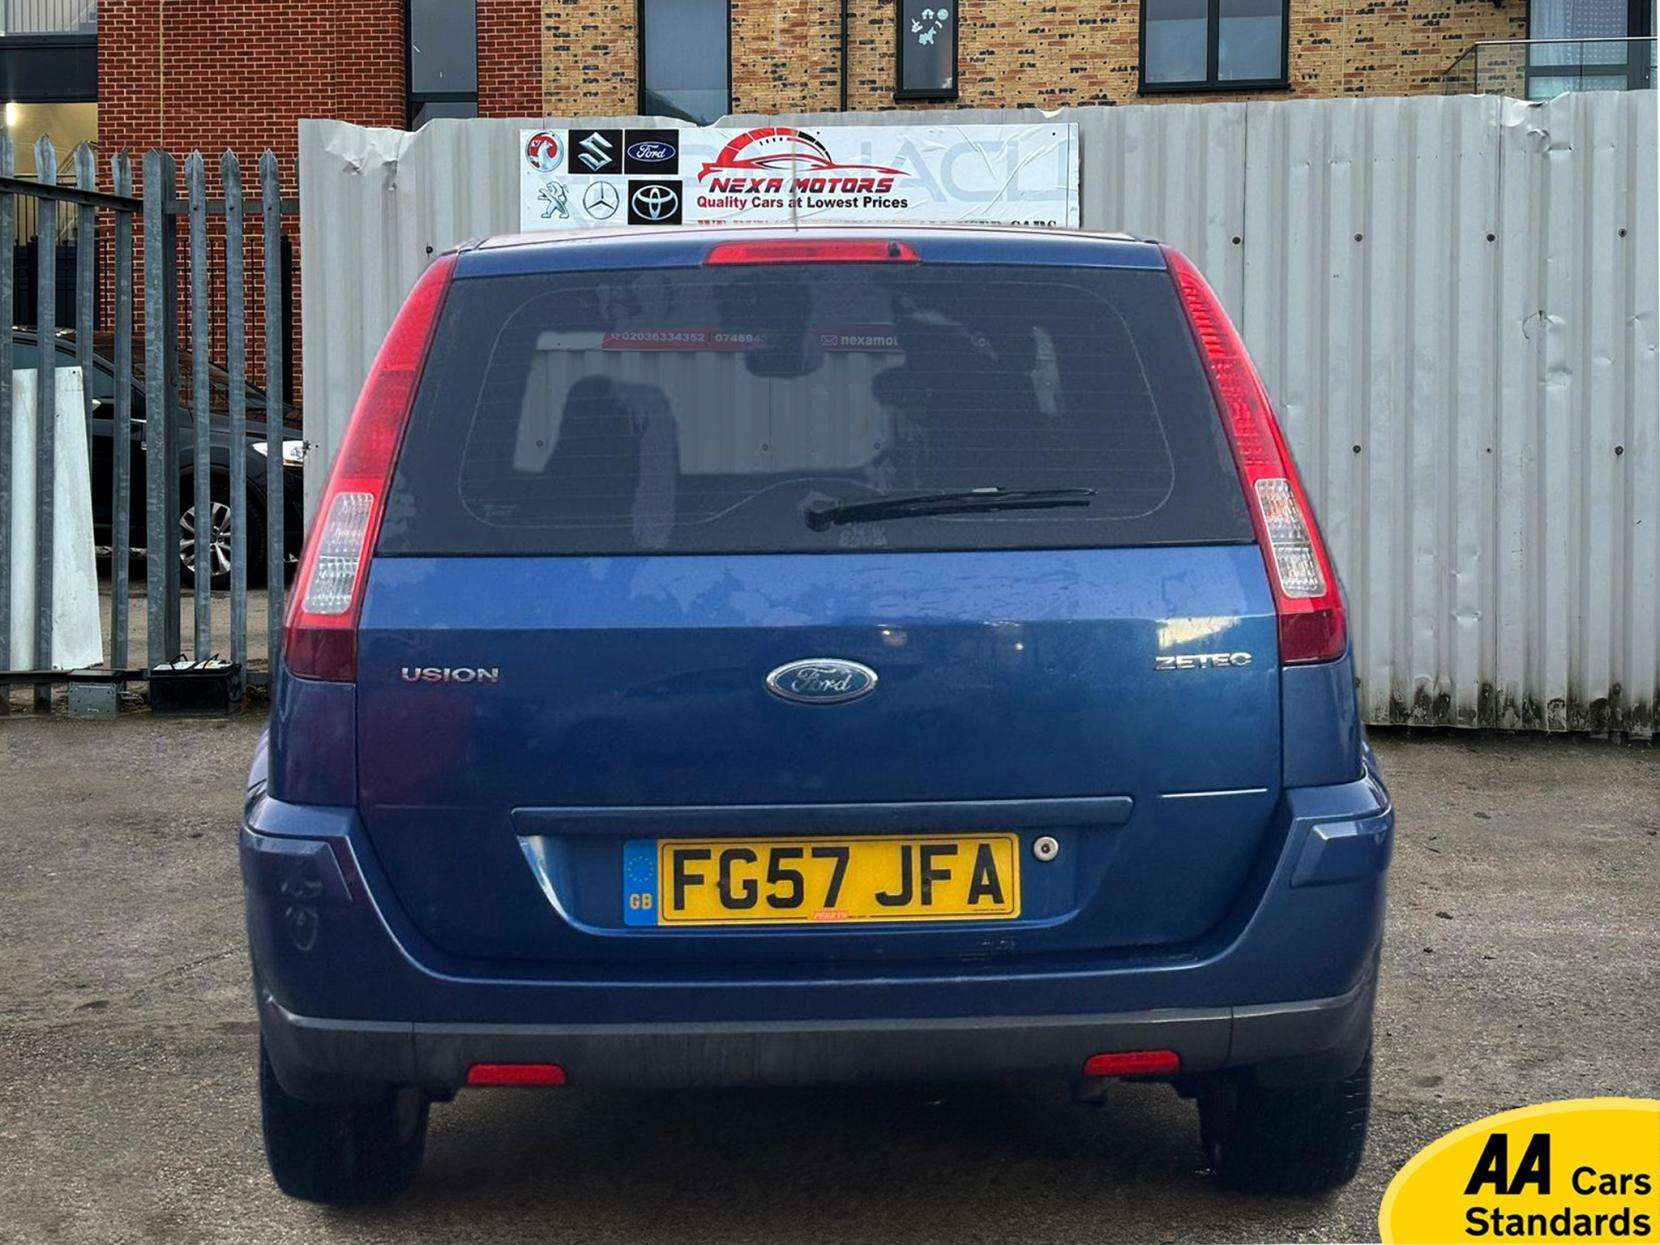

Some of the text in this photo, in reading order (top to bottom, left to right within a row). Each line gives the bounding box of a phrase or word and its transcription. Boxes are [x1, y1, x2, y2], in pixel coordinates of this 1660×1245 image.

[635, 143, 667, 159] Ford
[708, 177, 894, 194] NEXA MOTORS
[696, 196, 908, 210] Quality Cars at Lowest Prices
[1154, 651, 1252, 671] ZETEC
[401, 666, 499, 682] USION
[791, 666, 854, 693] Ford
[672, 842, 1005, 911] FG57 JFA
[630, 893, 652, 910] GB
